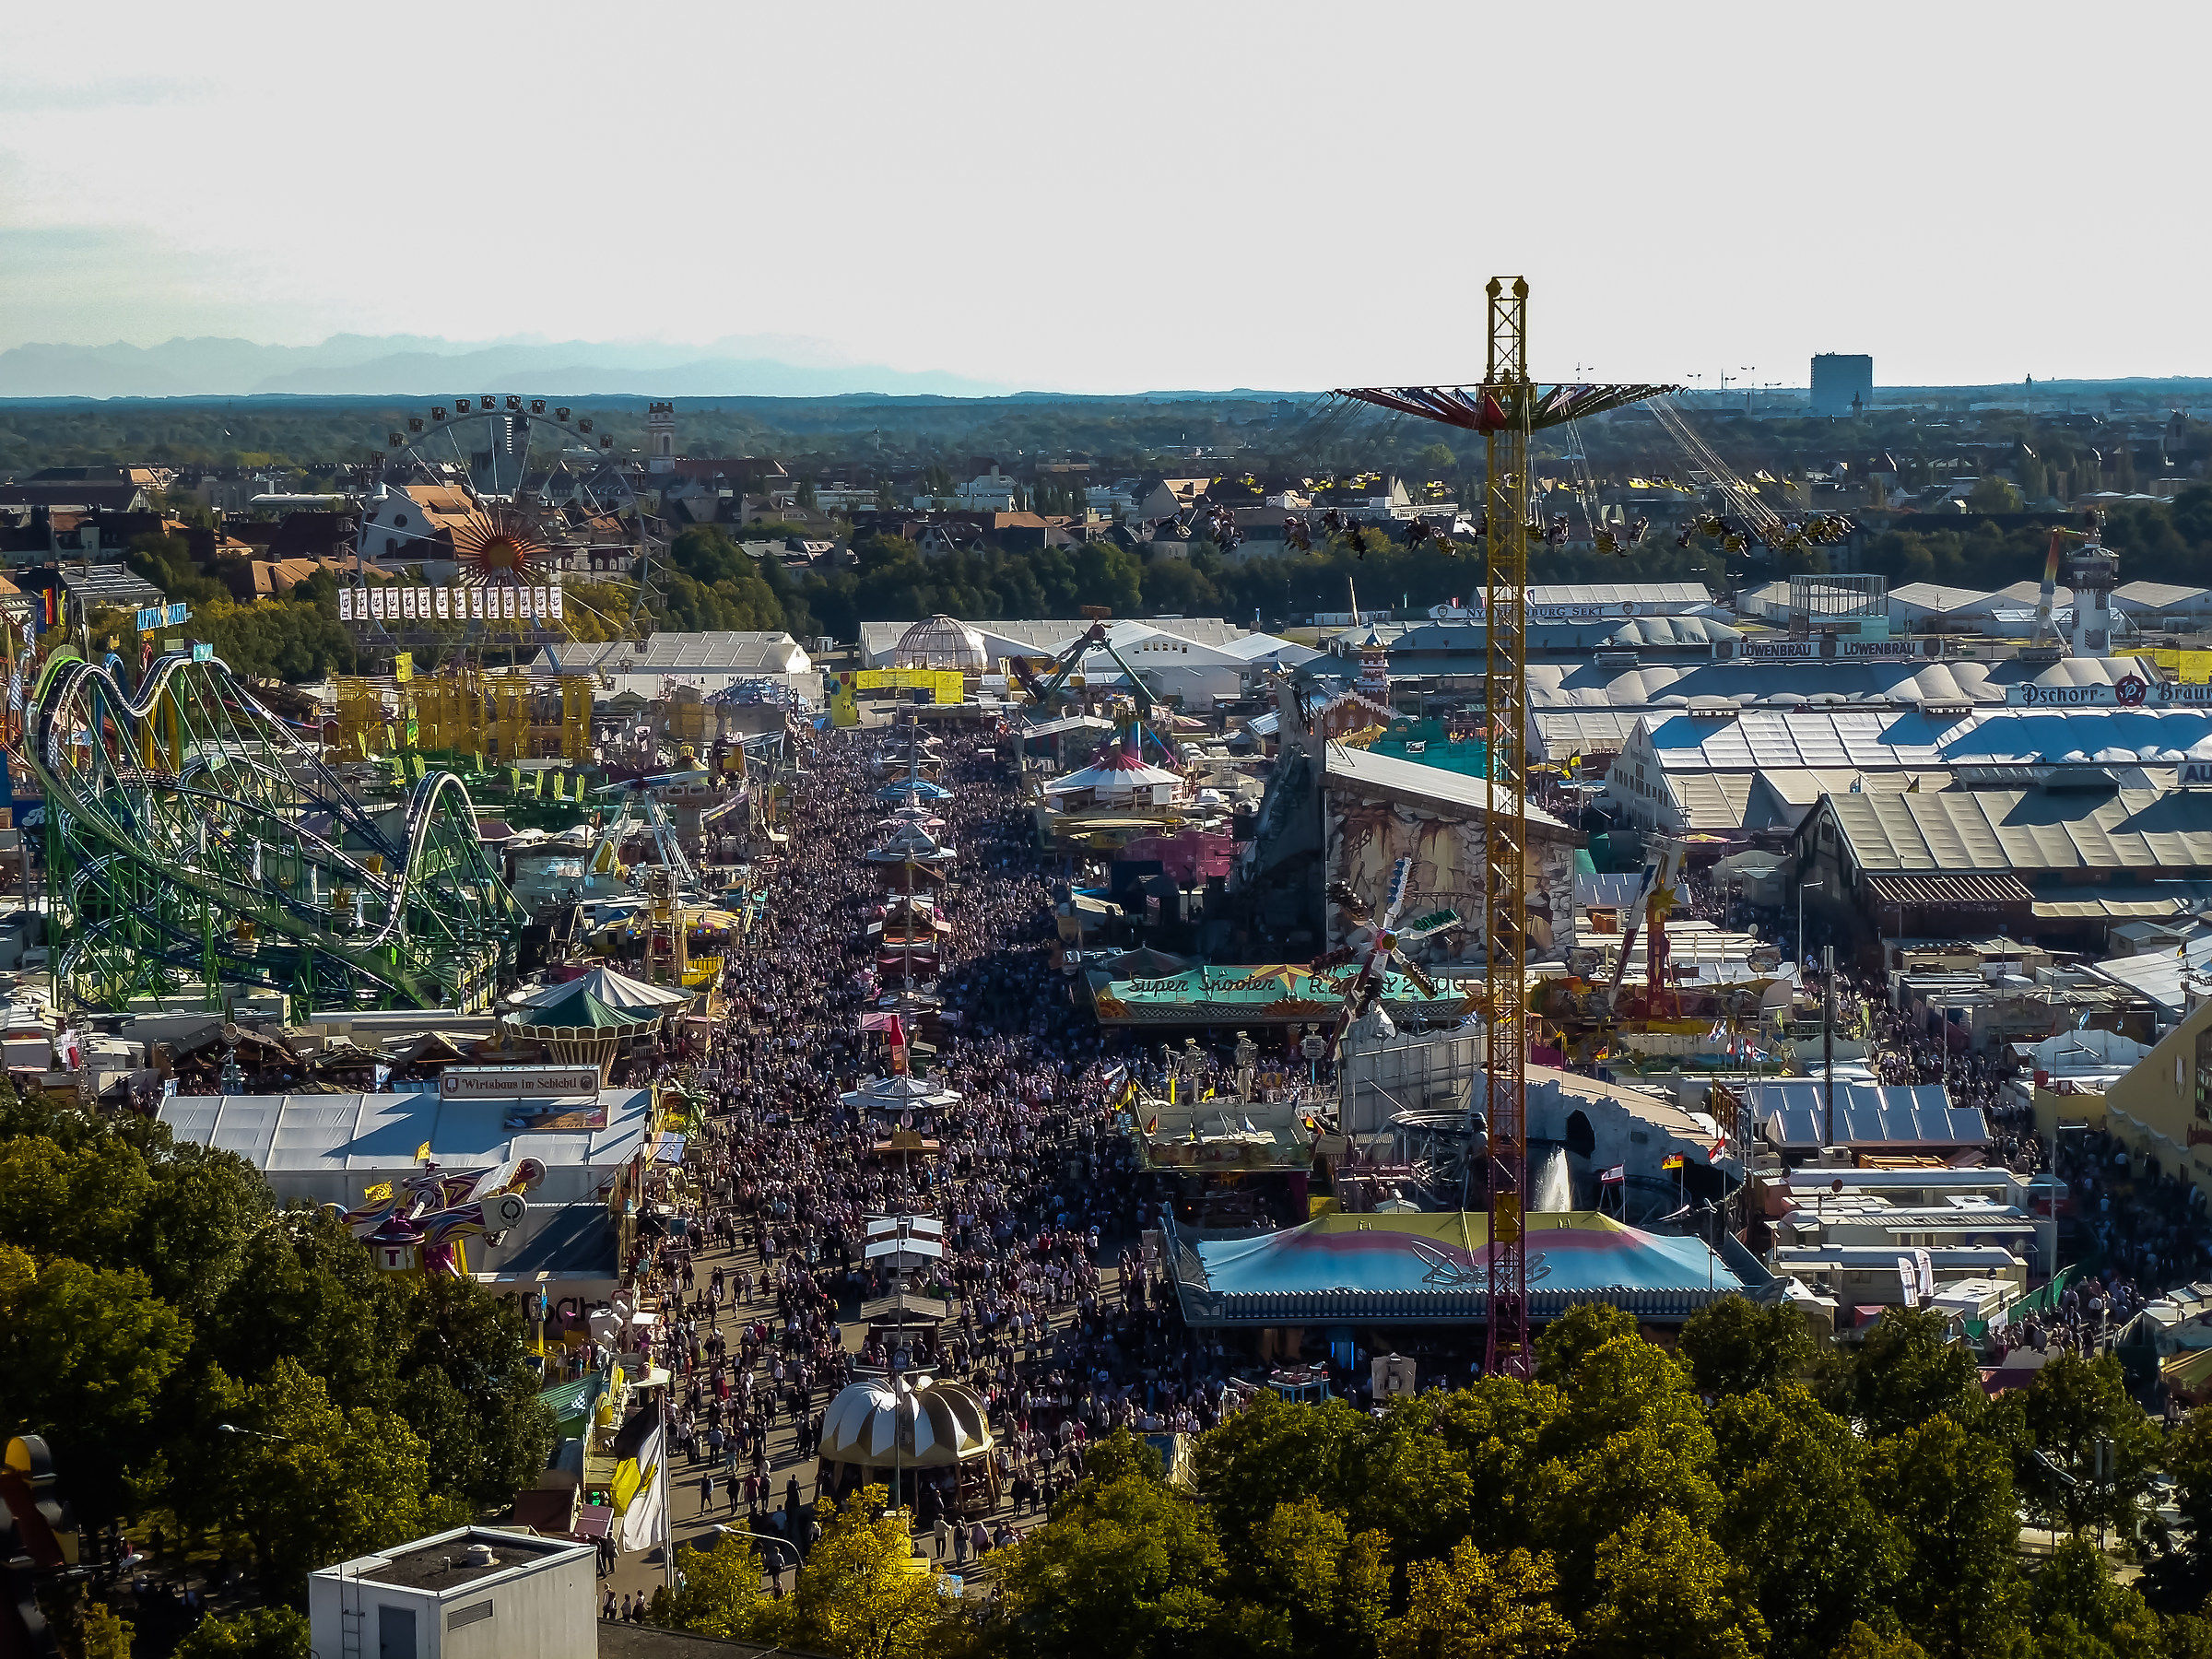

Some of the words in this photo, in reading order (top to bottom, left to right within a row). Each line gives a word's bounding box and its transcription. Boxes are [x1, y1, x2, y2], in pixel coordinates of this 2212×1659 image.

[1466, 606, 1566, 618] NYNBURG
[1571, 606, 1605, 617] SEKT
[1402, 976, 1467, 994] 200
[462, 1078, 518, 1090] Wirtshaus
[522, 1078, 535, 1090] im
[536, 1077, 578, 1090] Schichtl
[384, 1249, 401, 1267] T
